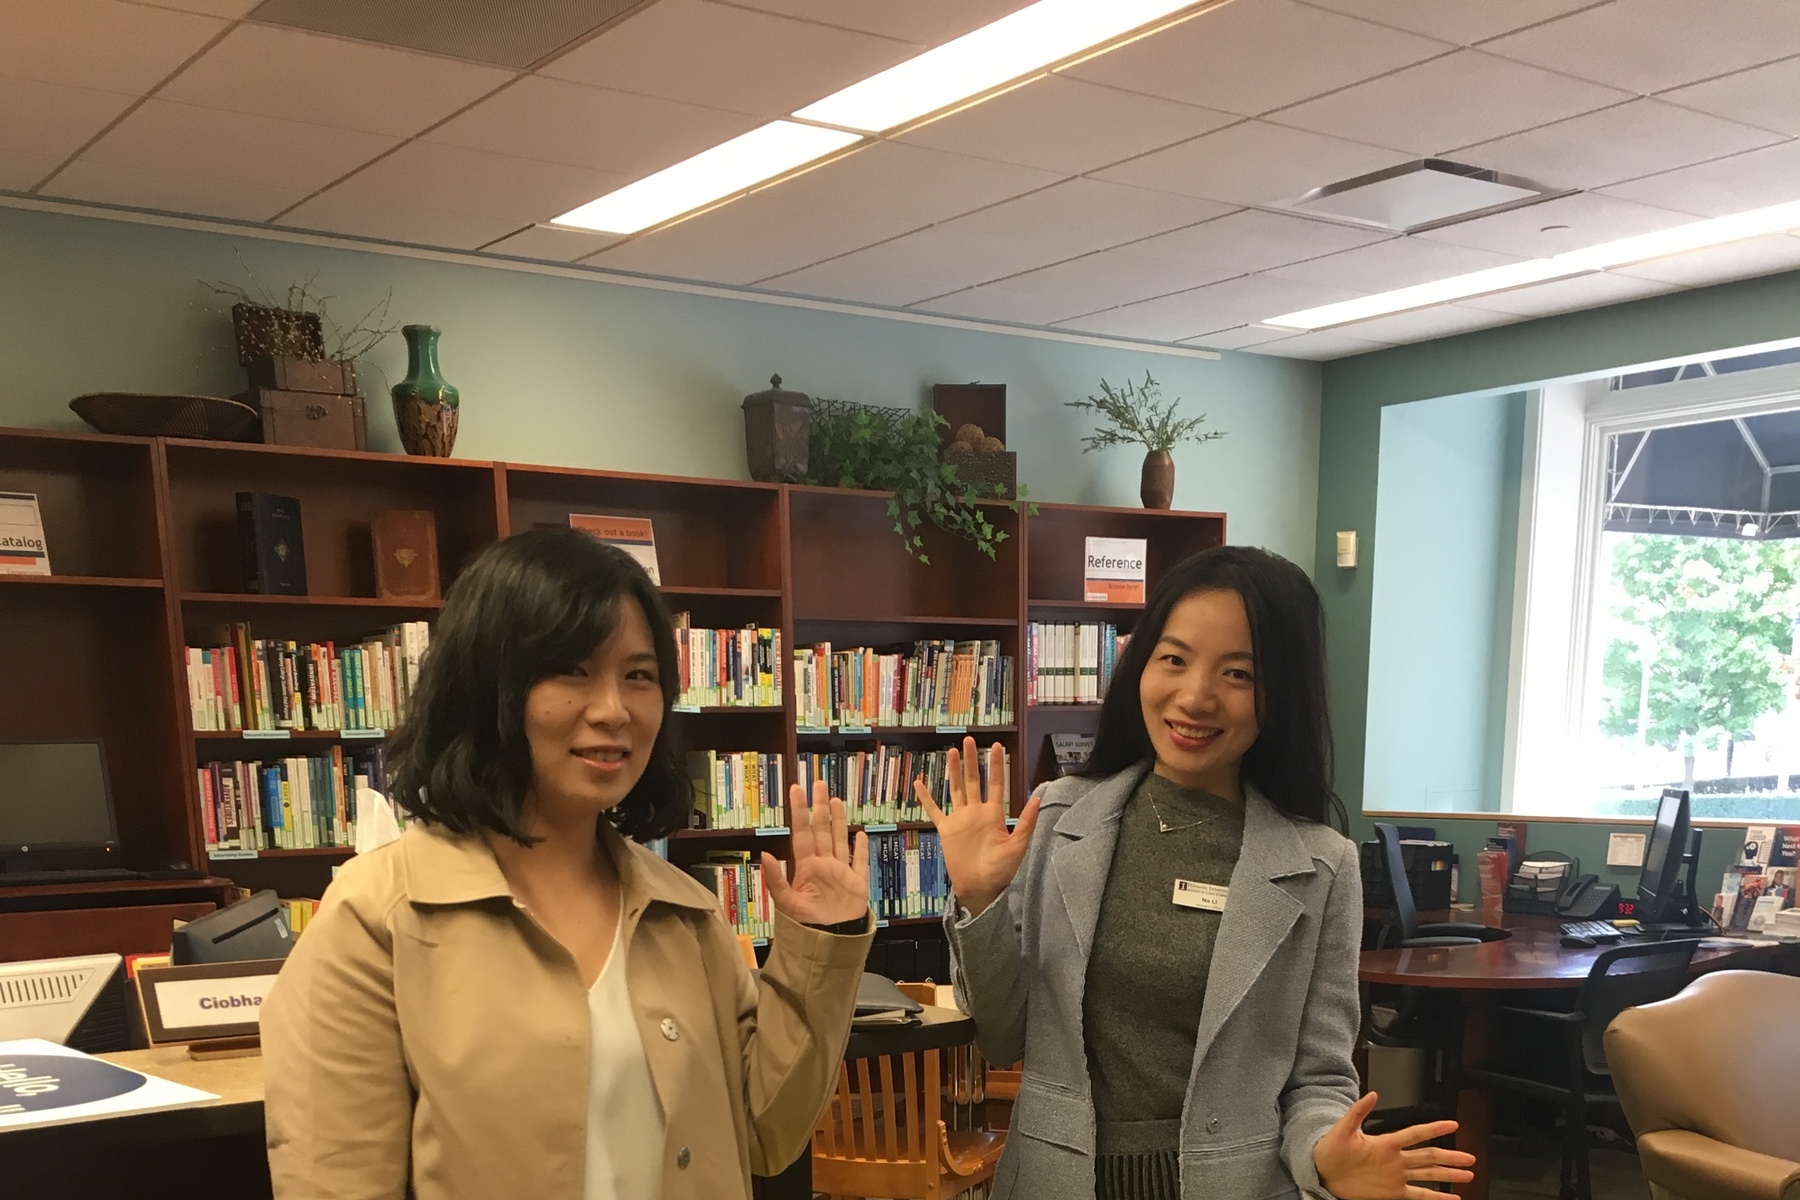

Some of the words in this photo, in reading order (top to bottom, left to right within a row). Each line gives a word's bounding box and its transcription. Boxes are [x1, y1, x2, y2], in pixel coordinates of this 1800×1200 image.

[626, 529, 648, 538] book!
[0, 536, 43, 551] atalog
[1087, 555, 1143, 570] Reference
[308, 663, 317, 700] INNOVATION
[282, 783, 290, 801] RESET
[223, 783, 234, 826] ADVENTURES
